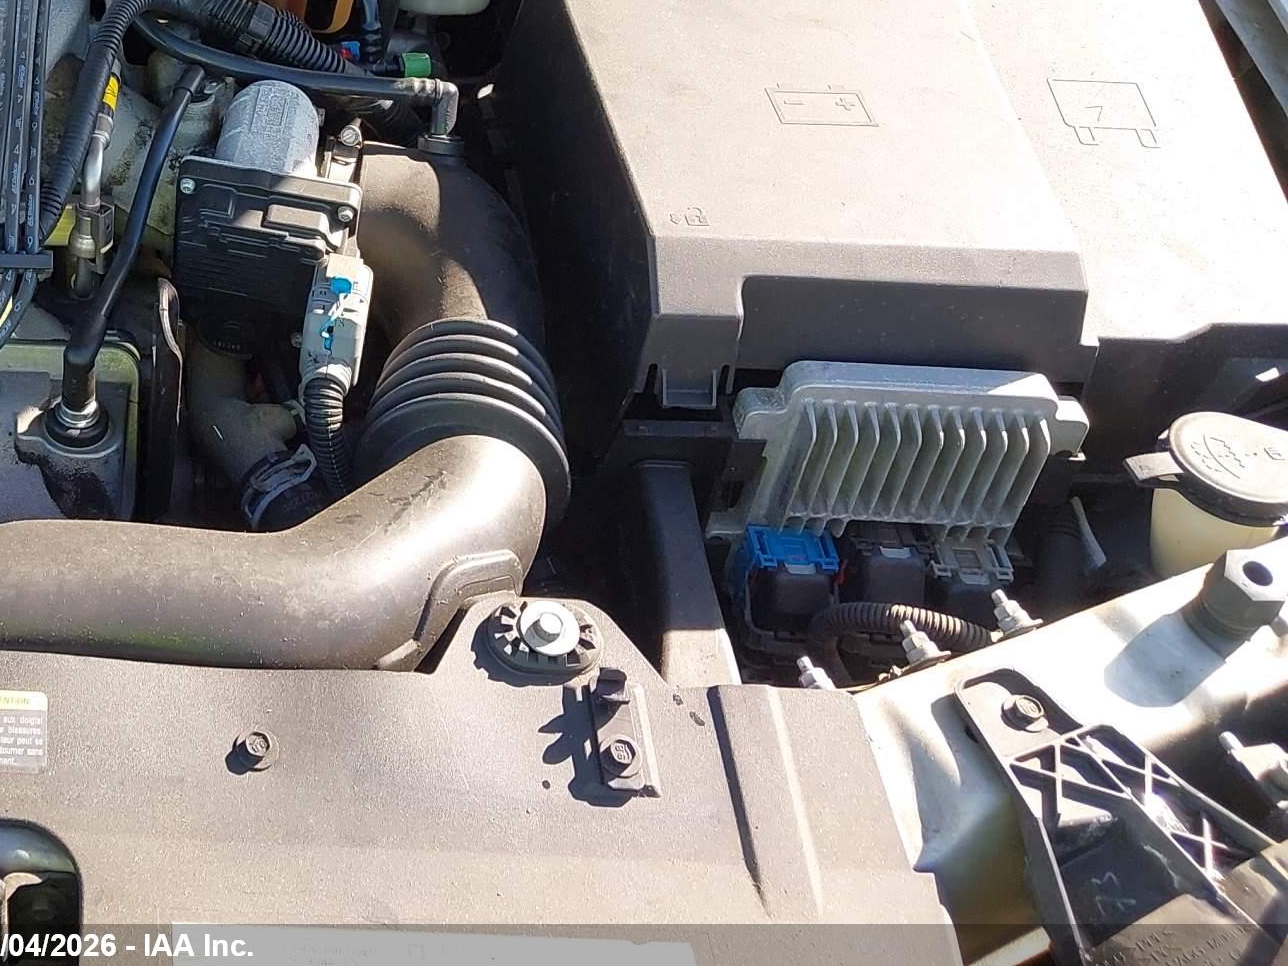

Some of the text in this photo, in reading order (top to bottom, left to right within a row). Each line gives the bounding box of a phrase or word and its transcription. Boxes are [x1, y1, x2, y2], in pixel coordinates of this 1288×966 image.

[2, 715, 16, 724] aux
[16, 737, 33, 747] peut
[34, 738, 44, 746] se
[0, 746, 25, 755] tourner
